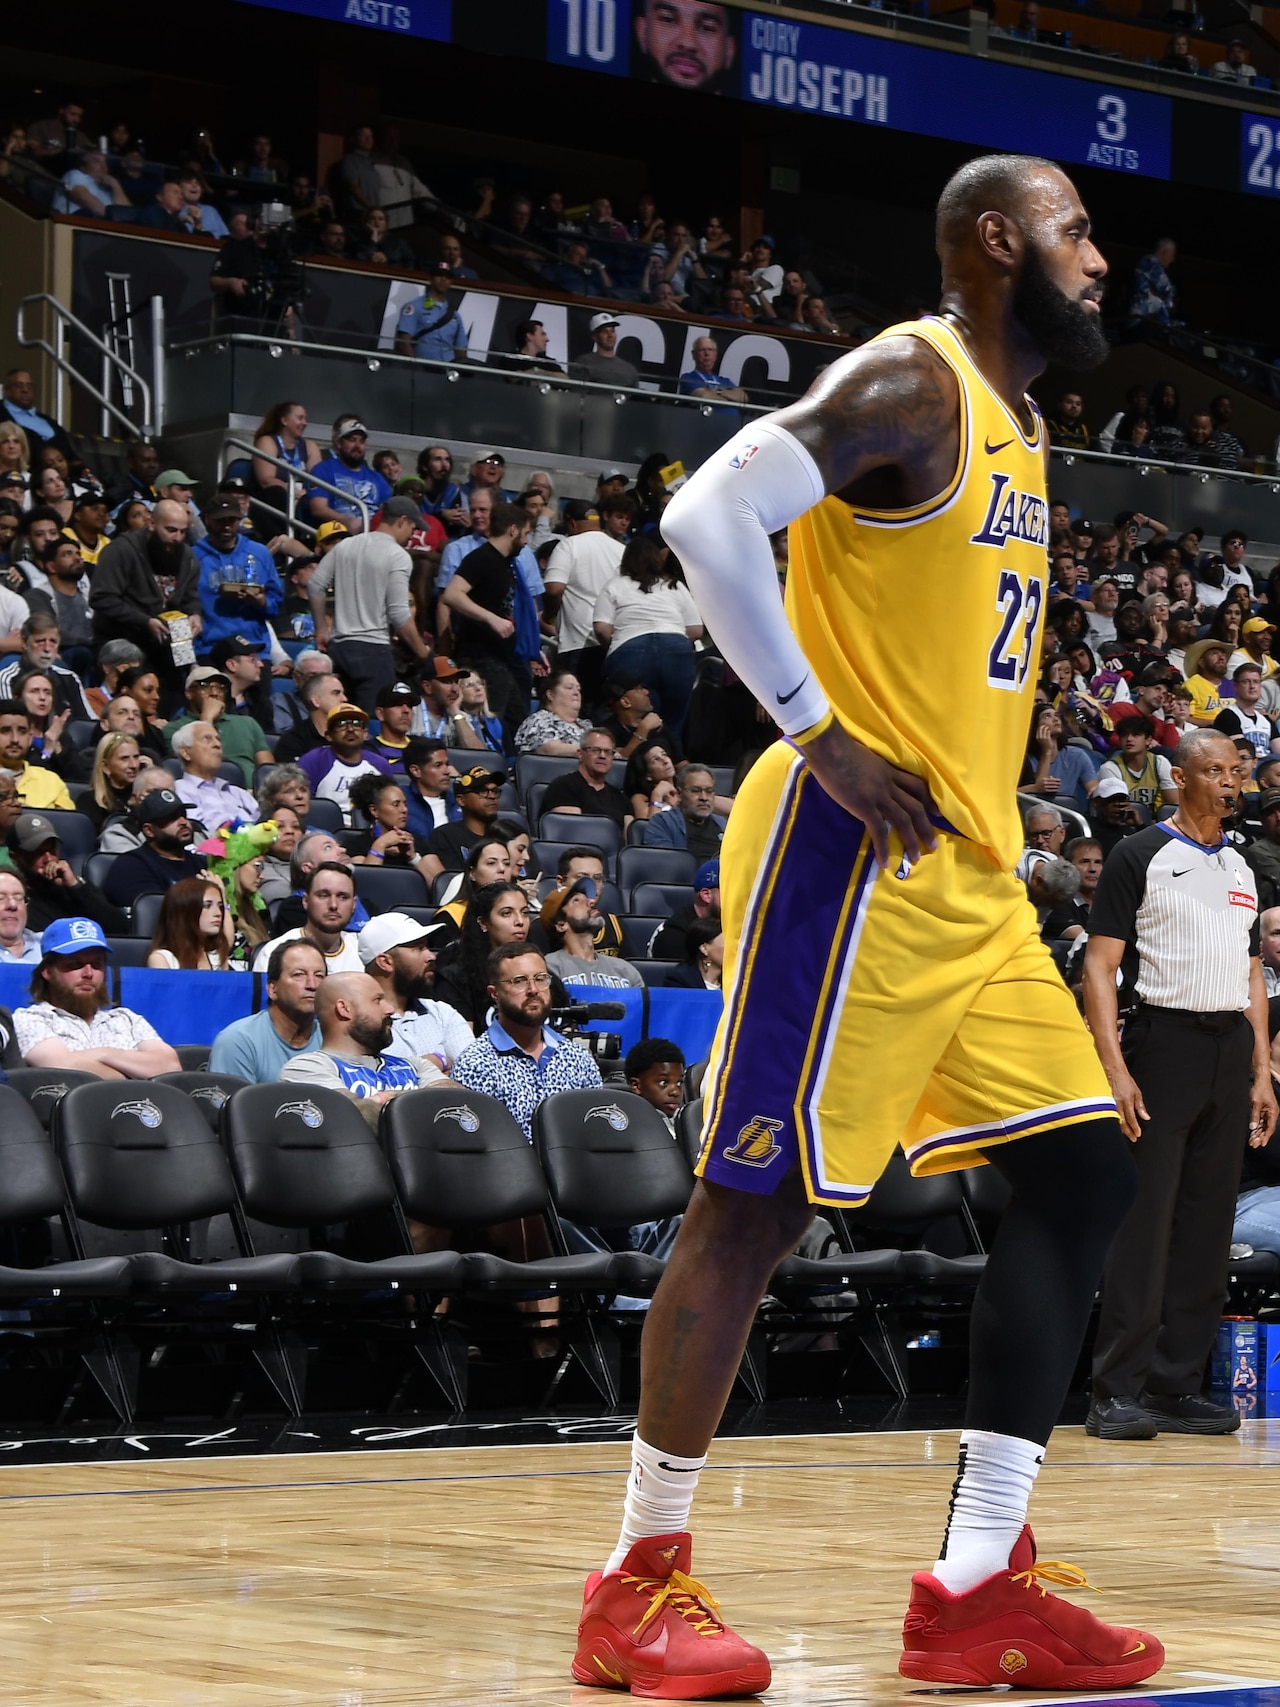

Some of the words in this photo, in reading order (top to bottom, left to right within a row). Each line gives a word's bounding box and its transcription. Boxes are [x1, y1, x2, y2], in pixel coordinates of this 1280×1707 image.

[344, 0, 411, 30] ASTS
[562, 0, 617, 63] 10
[752, 17, 800, 56] CORY
[751, 54, 888, 123] JOSEPH
[1096, 94, 1127, 142] 3
[1086, 142, 1140, 171] ASTS
[987, 568, 1043, 694] 23
[1105, 657, 1124, 673] 20
